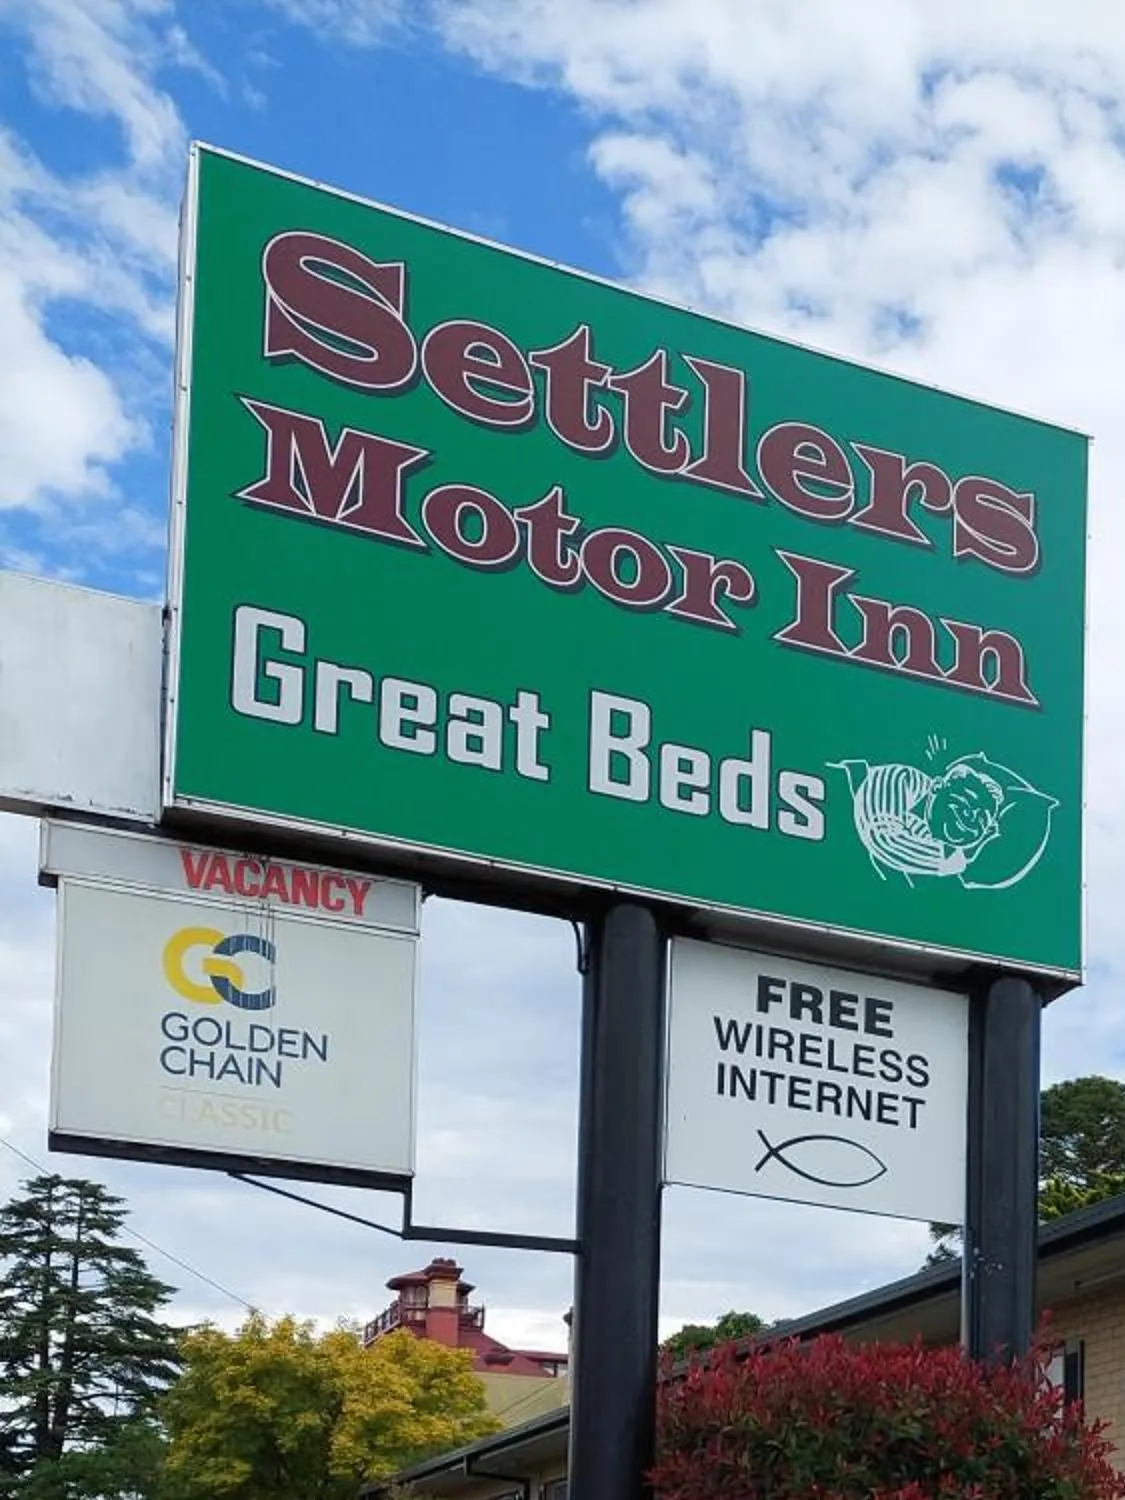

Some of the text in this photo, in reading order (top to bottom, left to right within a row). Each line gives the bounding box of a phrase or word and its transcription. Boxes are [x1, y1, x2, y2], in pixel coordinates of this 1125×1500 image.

[261, 230, 1042, 573] Settlers
[231, 394, 1041, 706] Motor Inn
[229, 604, 829, 842] Great Beds
[181, 849, 372, 916] VACANCY
[161, 1012, 327, 1062] GOLDEN
[756, 974, 894, 1038] FREE
[160, 1046, 281, 1088] CHAIN
[713, 1016, 930, 1088] WIRELESS
[717, 1062, 926, 1129] INTERNET
